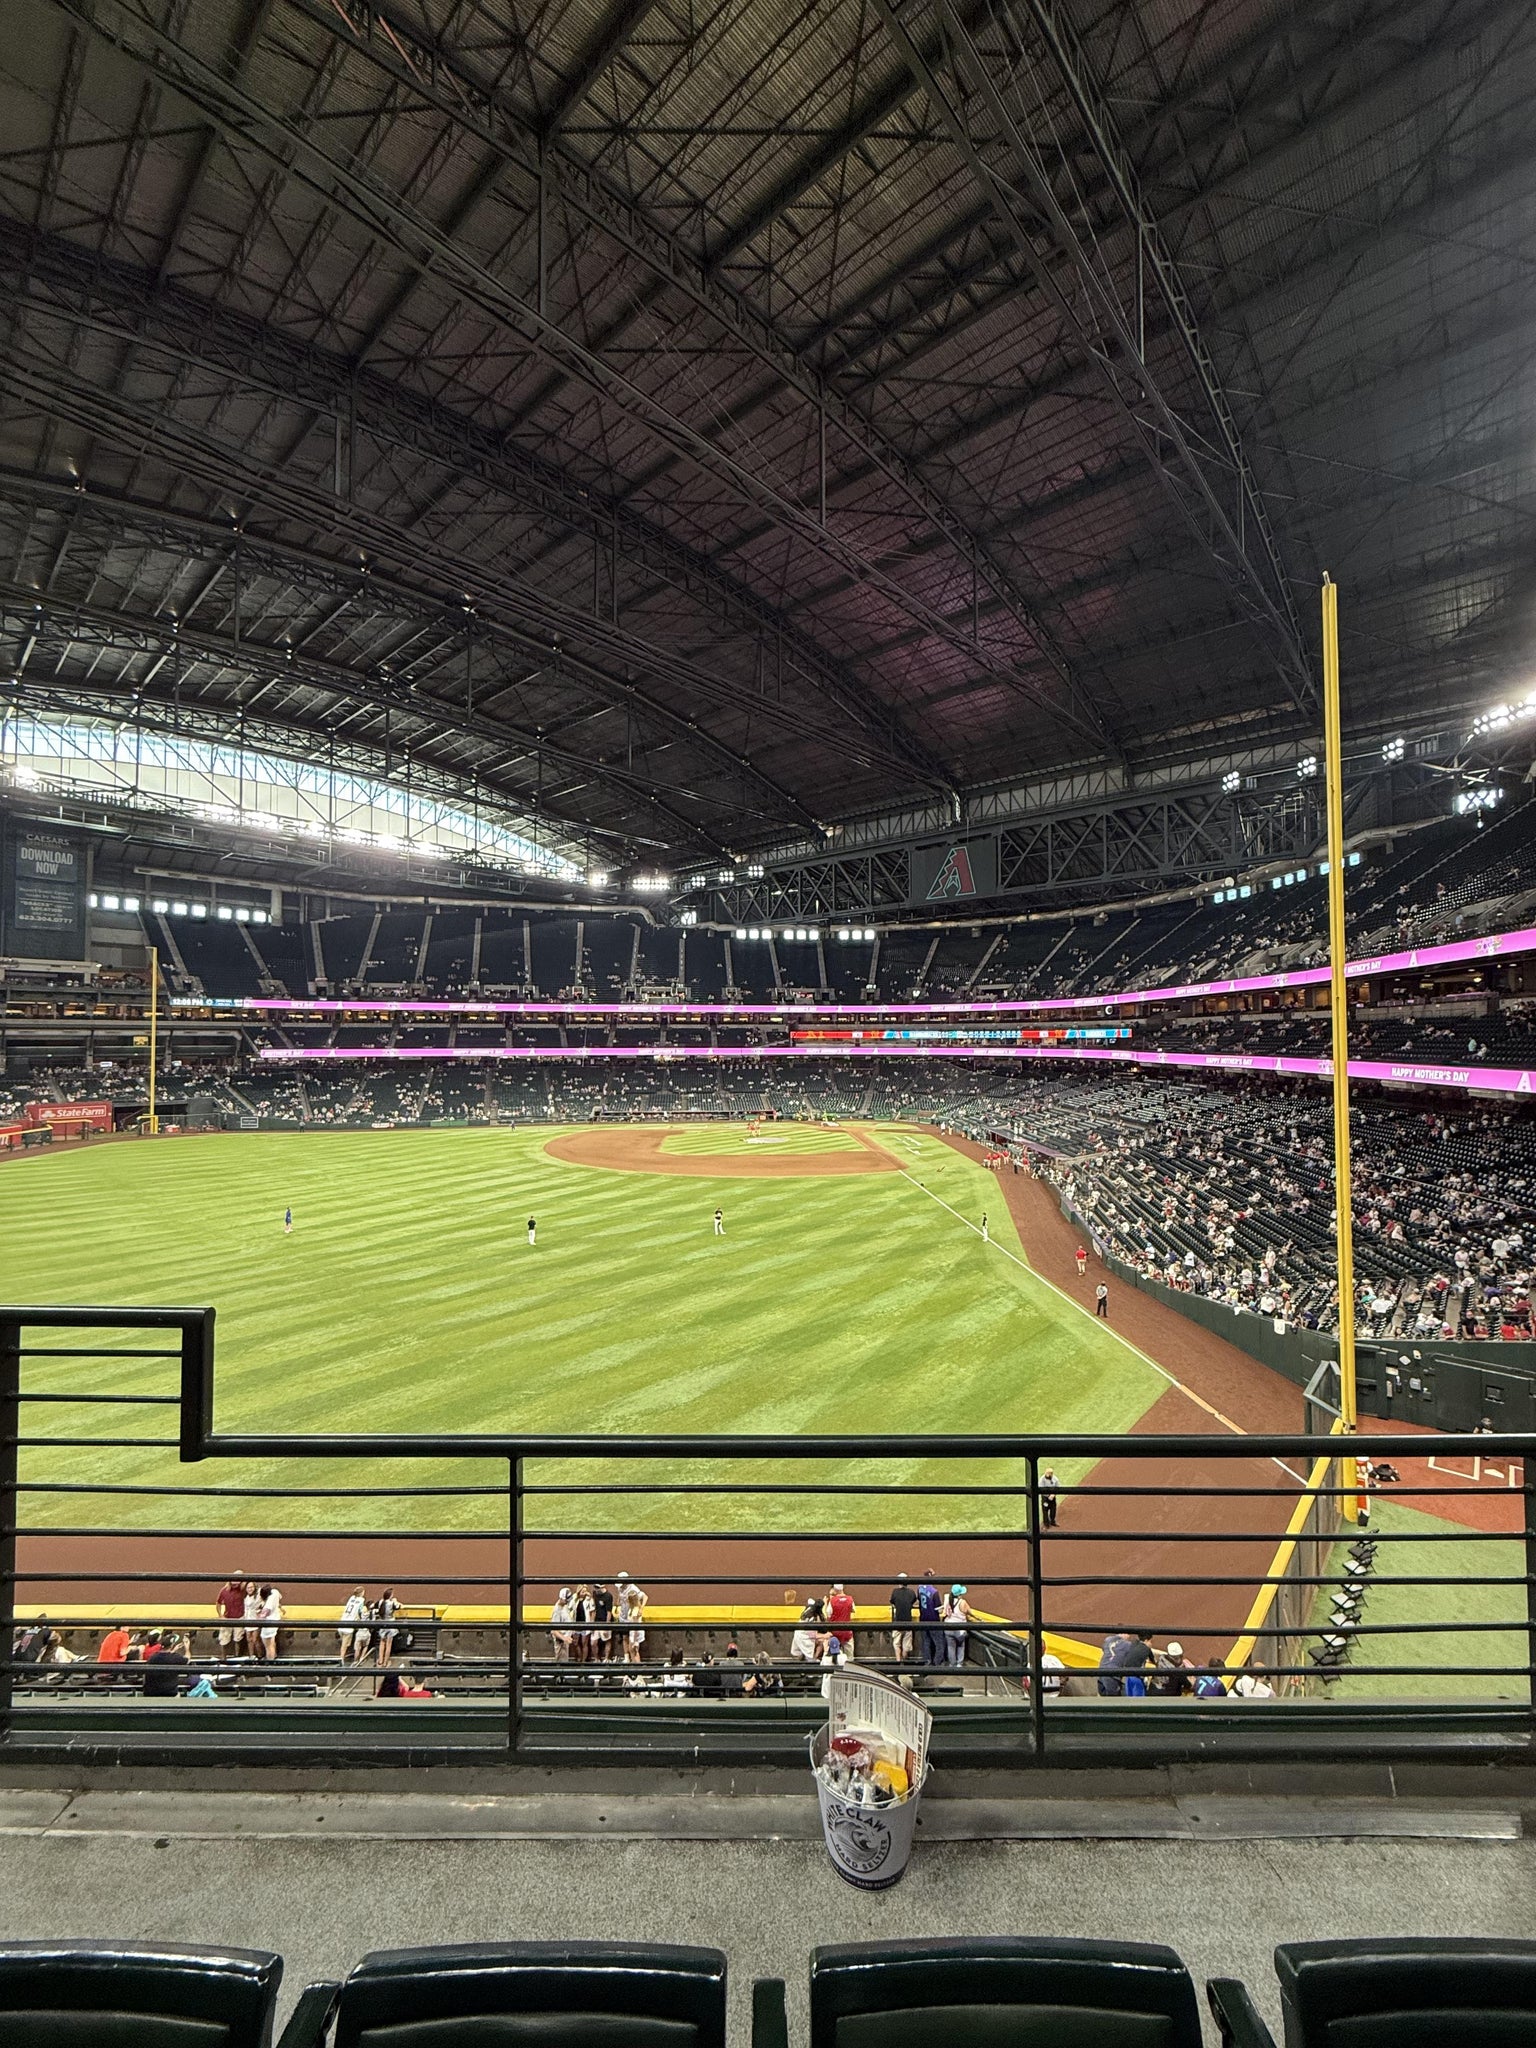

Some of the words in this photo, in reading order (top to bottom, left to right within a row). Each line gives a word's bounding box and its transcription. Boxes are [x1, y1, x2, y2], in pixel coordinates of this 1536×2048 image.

[26, 833, 70, 846] CAESARS
[21, 847, 73, 865] DOWNLOAD
[36, 861, 59, 875] NOW
[1391, 1067, 1414, 1078] HAPPY
[1414, 1068, 1452, 1081] MOTHER'S
[1452, 1070, 1470, 1083] DAY
[57, 1109, 81, 1118] State
[82, 1107, 105, 1117] Farm
[845, 1807, 887, 1833] CLAW
[835, 1843, 859, 1869] HARD
[862, 1839, 888, 1871] SELTZER
